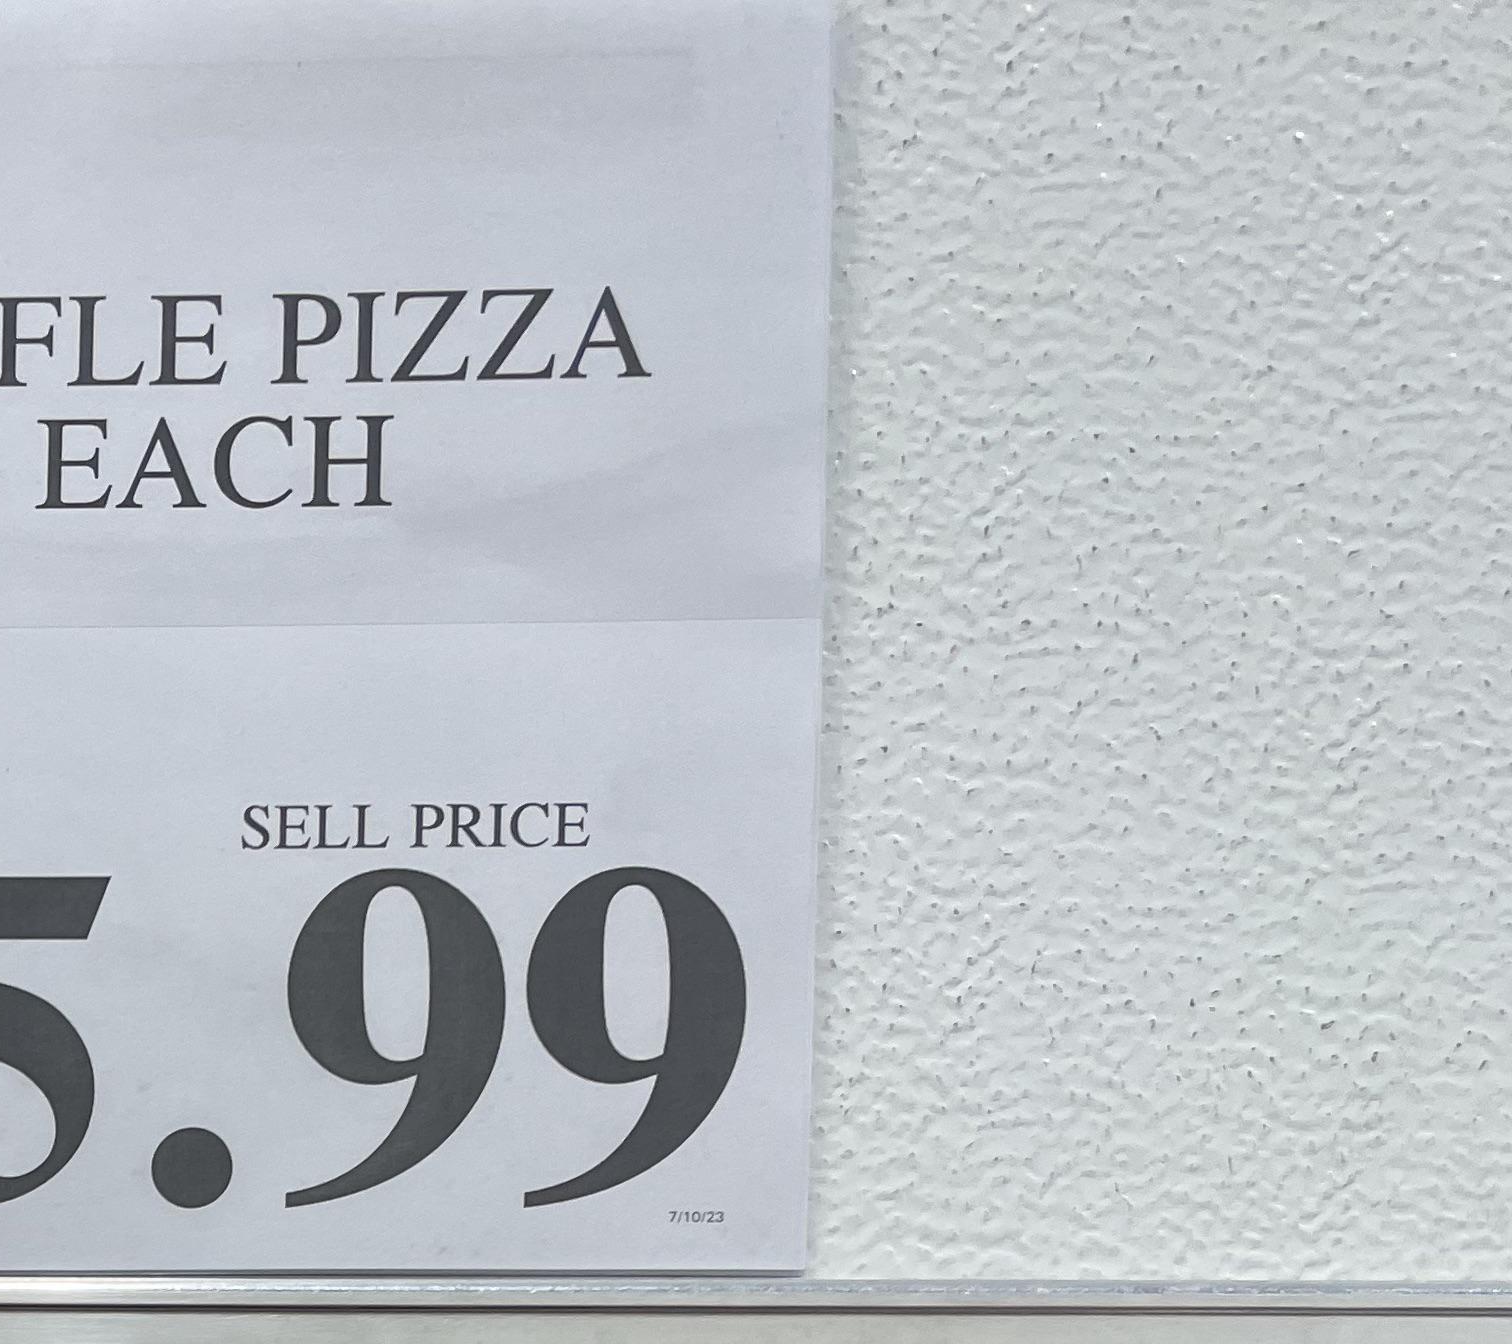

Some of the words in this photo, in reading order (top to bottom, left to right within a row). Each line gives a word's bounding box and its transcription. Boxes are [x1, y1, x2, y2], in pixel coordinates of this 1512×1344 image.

[268, 285, 653, 386] PIZZA
[33, 413, 396, 510] EACH
[241, 804, 390, 850] SELL
[410, 802, 591, 849] PRICE
[669, 1211, 725, 1223] 7/10/23
